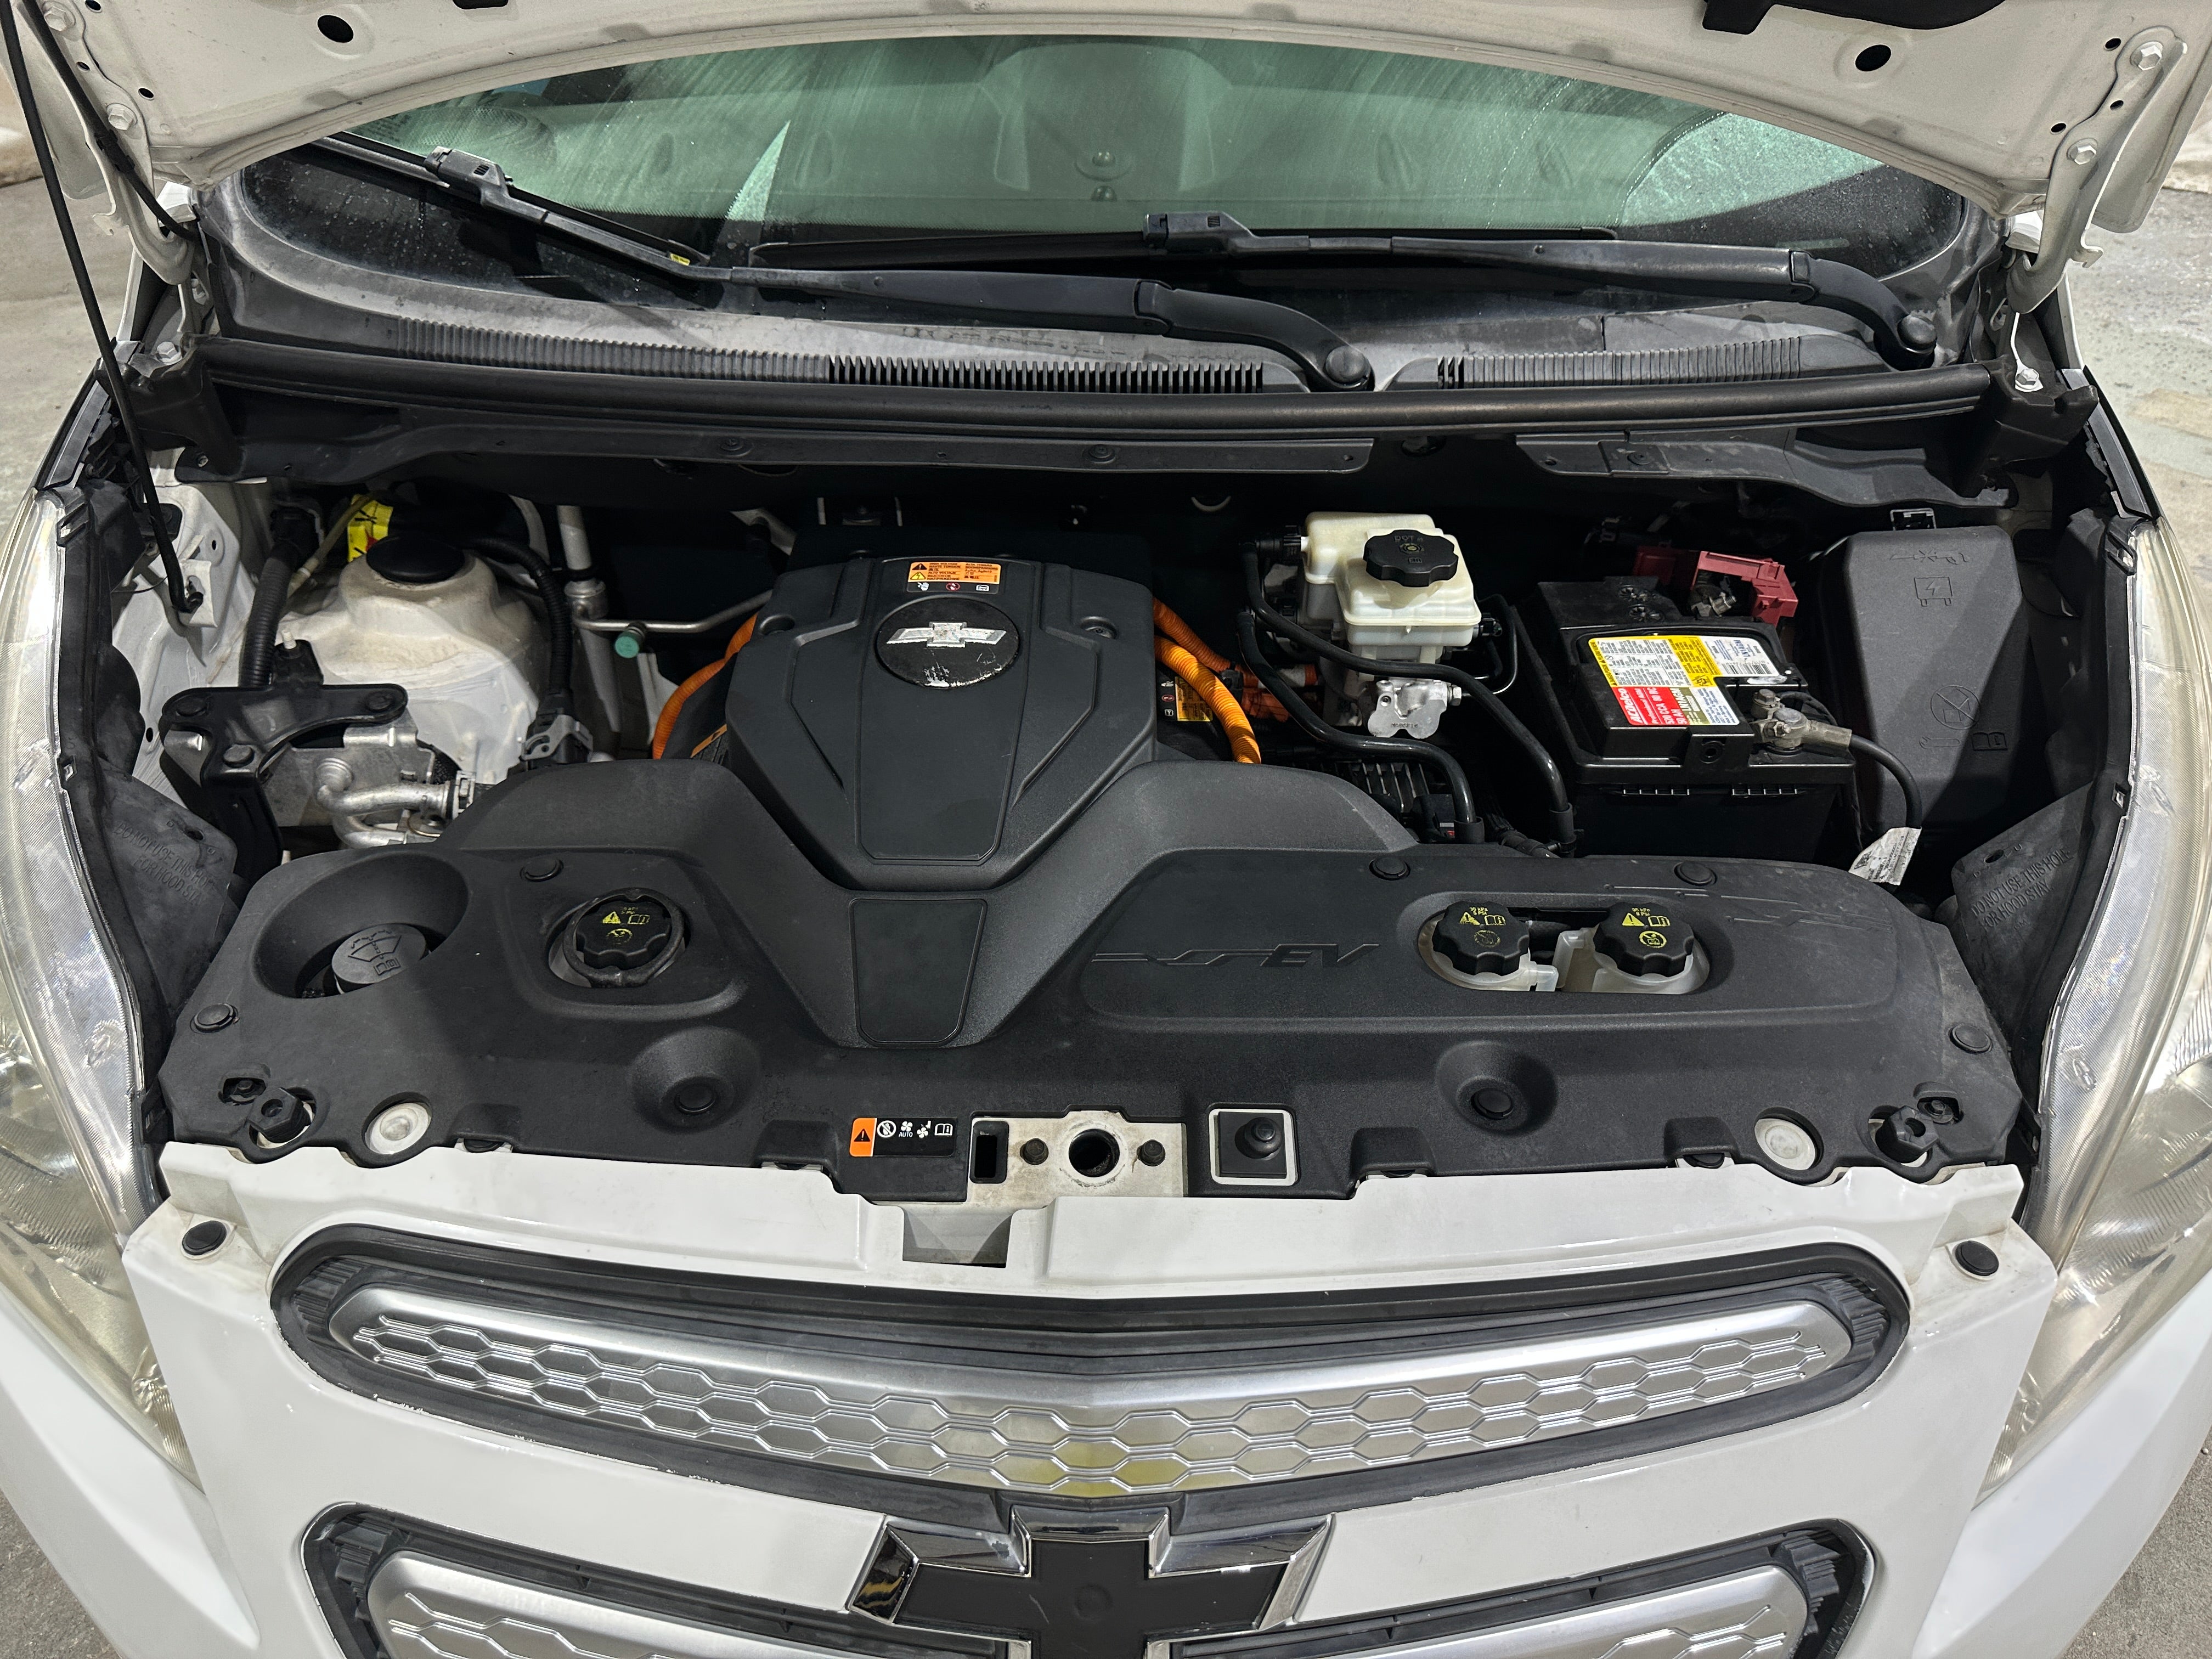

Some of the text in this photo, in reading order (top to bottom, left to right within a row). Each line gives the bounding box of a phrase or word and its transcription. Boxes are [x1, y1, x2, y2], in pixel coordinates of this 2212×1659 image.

[1616, 687, 1644, 723] ACDelco
[1655, 703, 1670, 714] CCA
[1669, 688, 1692, 712] LN1AGM
[1670, 708, 1684, 716] AH
[1661, 715, 1675, 724] 520
[131, 832, 153, 852] NOT
[152, 844, 176, 863] USE
[172, 855, 195, 877] THIS
[133, 855, 158, 874] FOR
[156, 867, 185, 892] HOOD
[1983, 887, 2006, 909] NOT
[2001, 876, 2023, 895] USE
[2021, 862, 2046, 882] THIS
[1997, 895, 2028, 920] HOOD
[1260, 943, 1380, 967] EV
